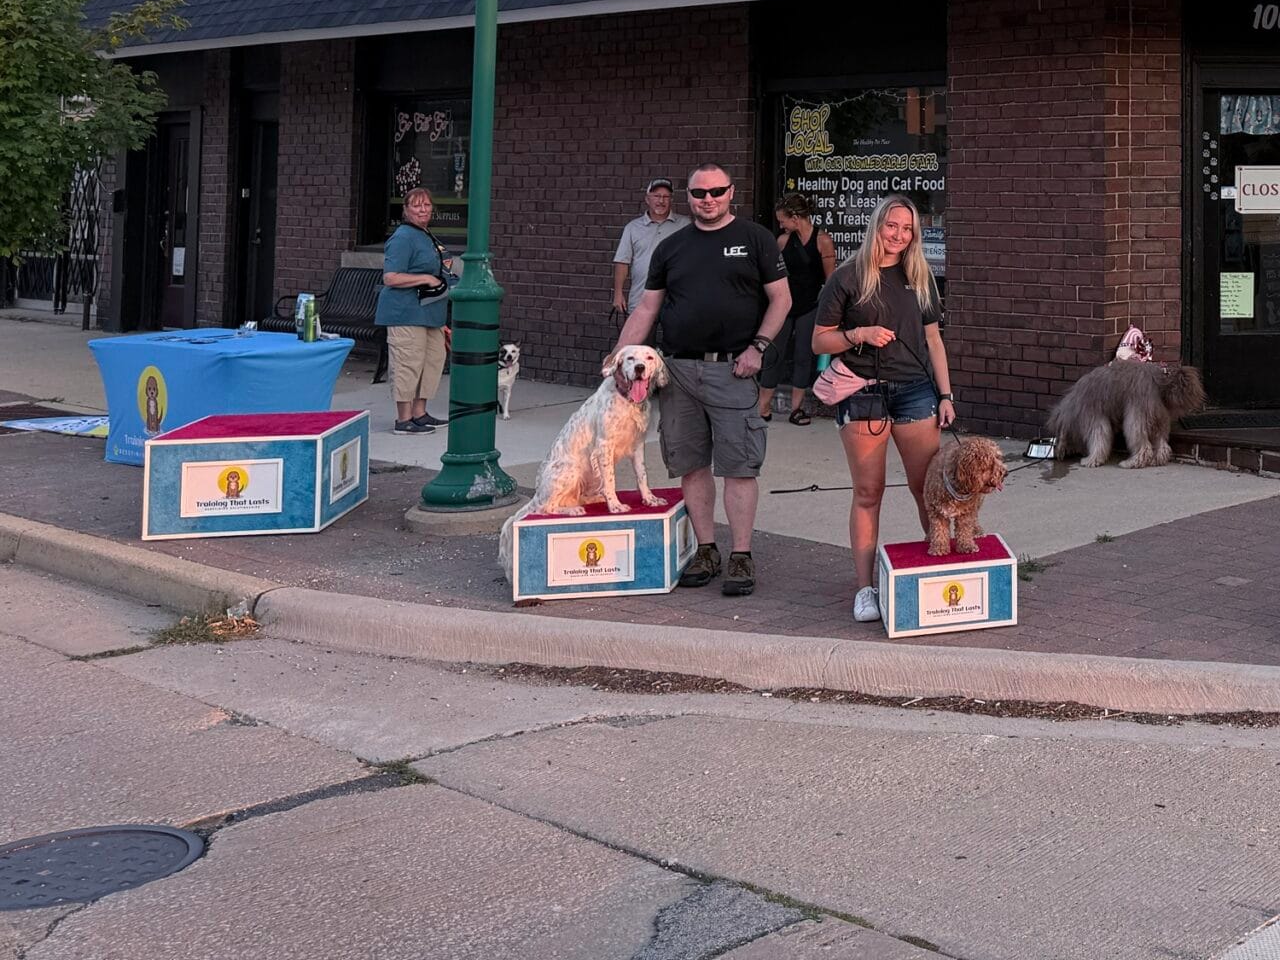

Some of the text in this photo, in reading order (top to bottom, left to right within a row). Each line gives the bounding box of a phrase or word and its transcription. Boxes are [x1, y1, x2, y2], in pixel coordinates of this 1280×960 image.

[790, 104, 831, 133] SHOP
[785, 131, 834, 157] LOCAL
[805, 156, 824, 172] WITH
[825, 156, 844, 171] OUR
[797, 176, 945, 193] Healthy Dog and Cat Food
[838, 194, 847, 208] &
[825, 211, 834, 225] &
[837, 211, 871, 225] Treats
[196, 500, 228, 508] Training
[926, 607, 951, 615] Training
